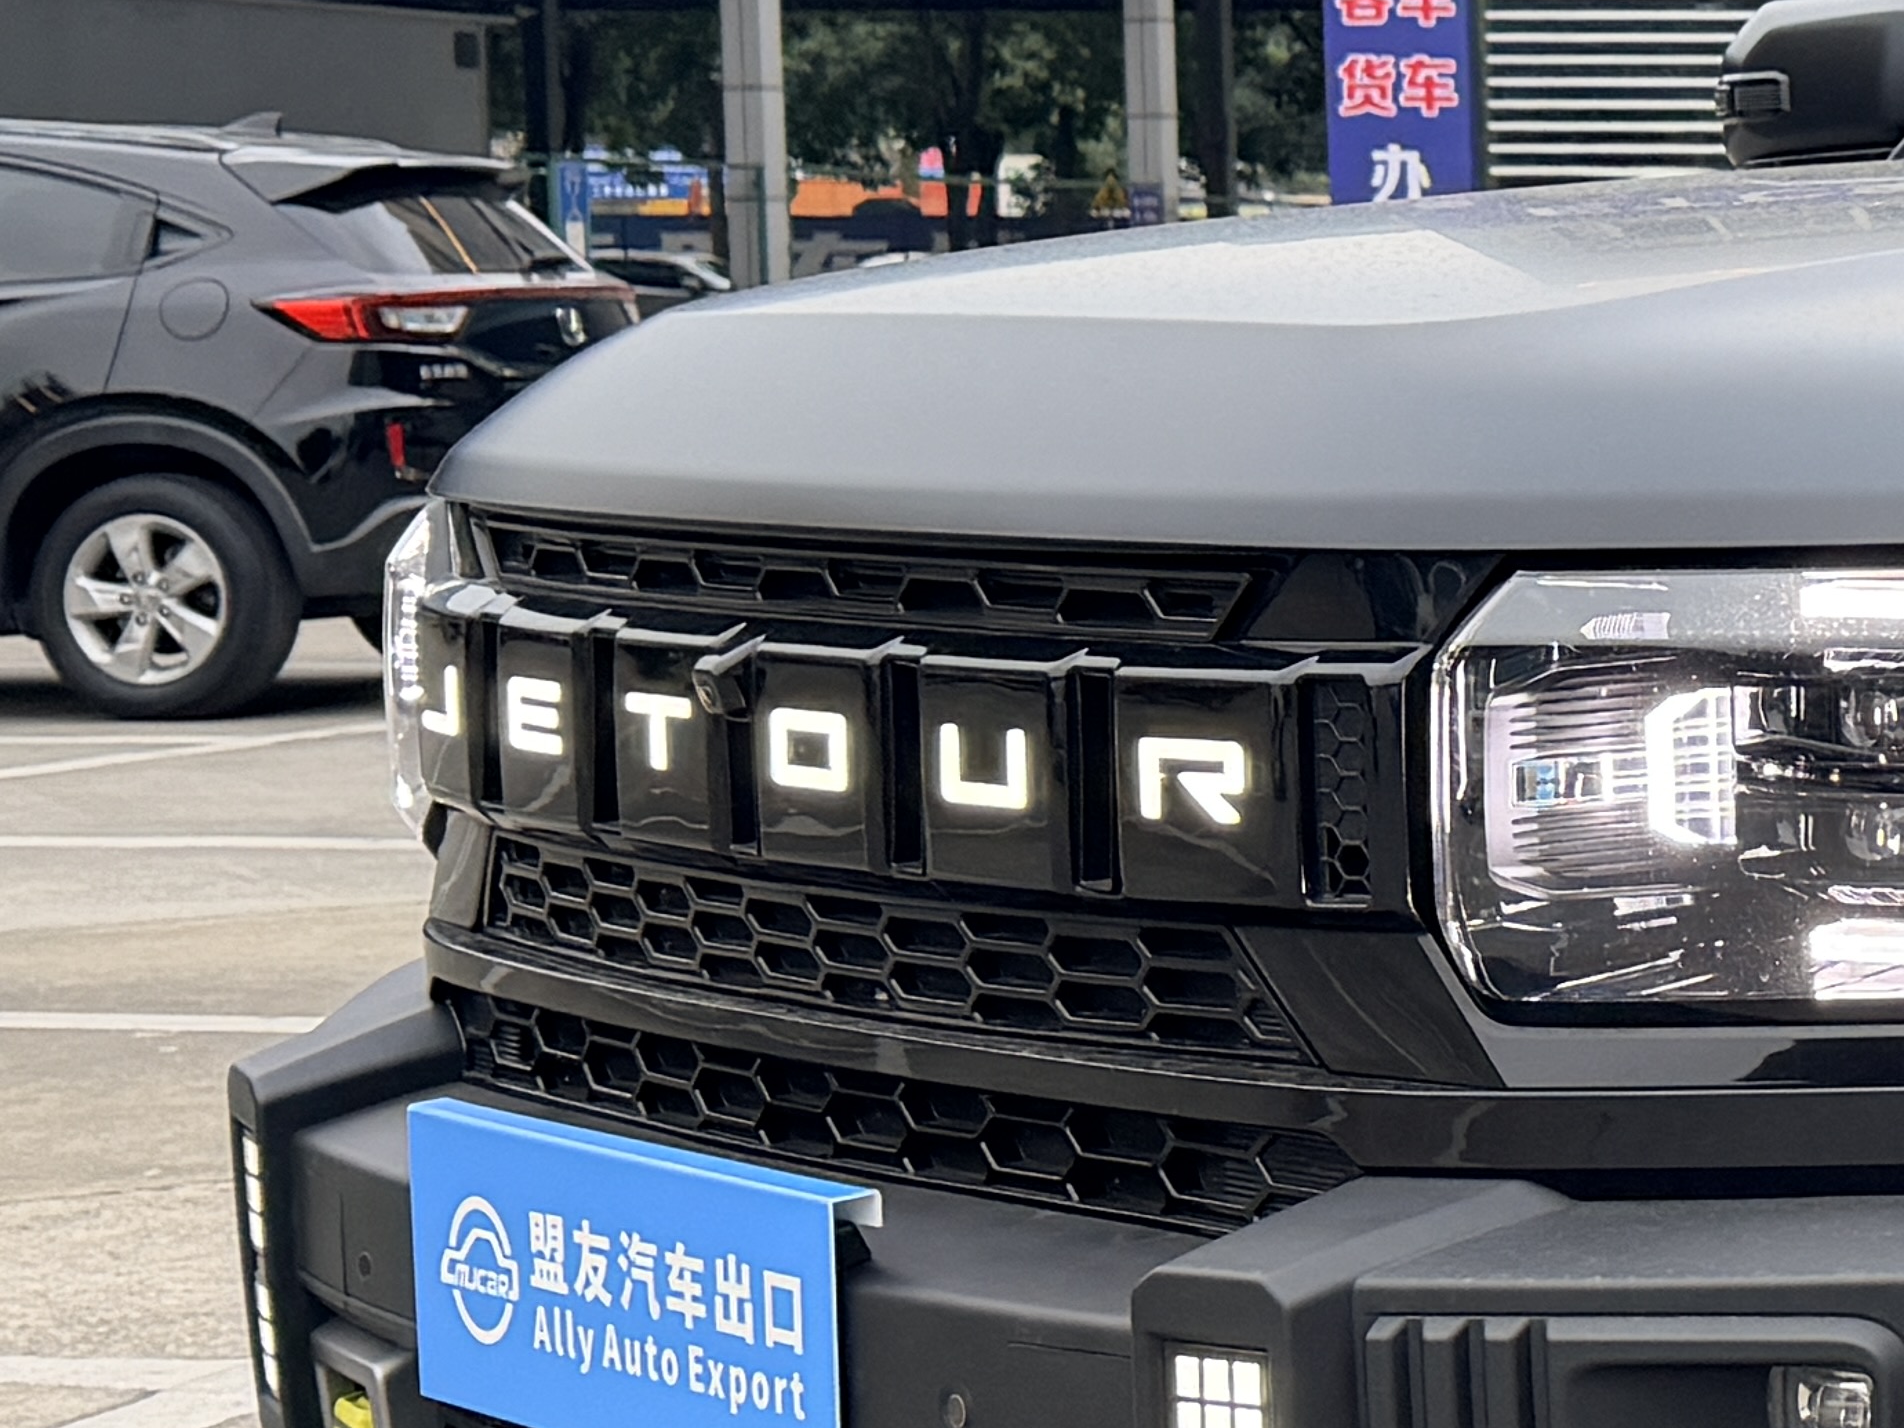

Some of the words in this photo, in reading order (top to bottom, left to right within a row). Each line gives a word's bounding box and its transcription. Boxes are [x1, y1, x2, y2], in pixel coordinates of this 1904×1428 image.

[1338, 53, 1460, 119] 货车
[421, 664, 1247, 827] JETOUR
[527, 1209, 806, 1357] 盟友汽车出口
[532, 1304, 596, 1375] Ally
[601, 1322, 680, 1387] Auto
[687, 1345, 807, 1422] Export
